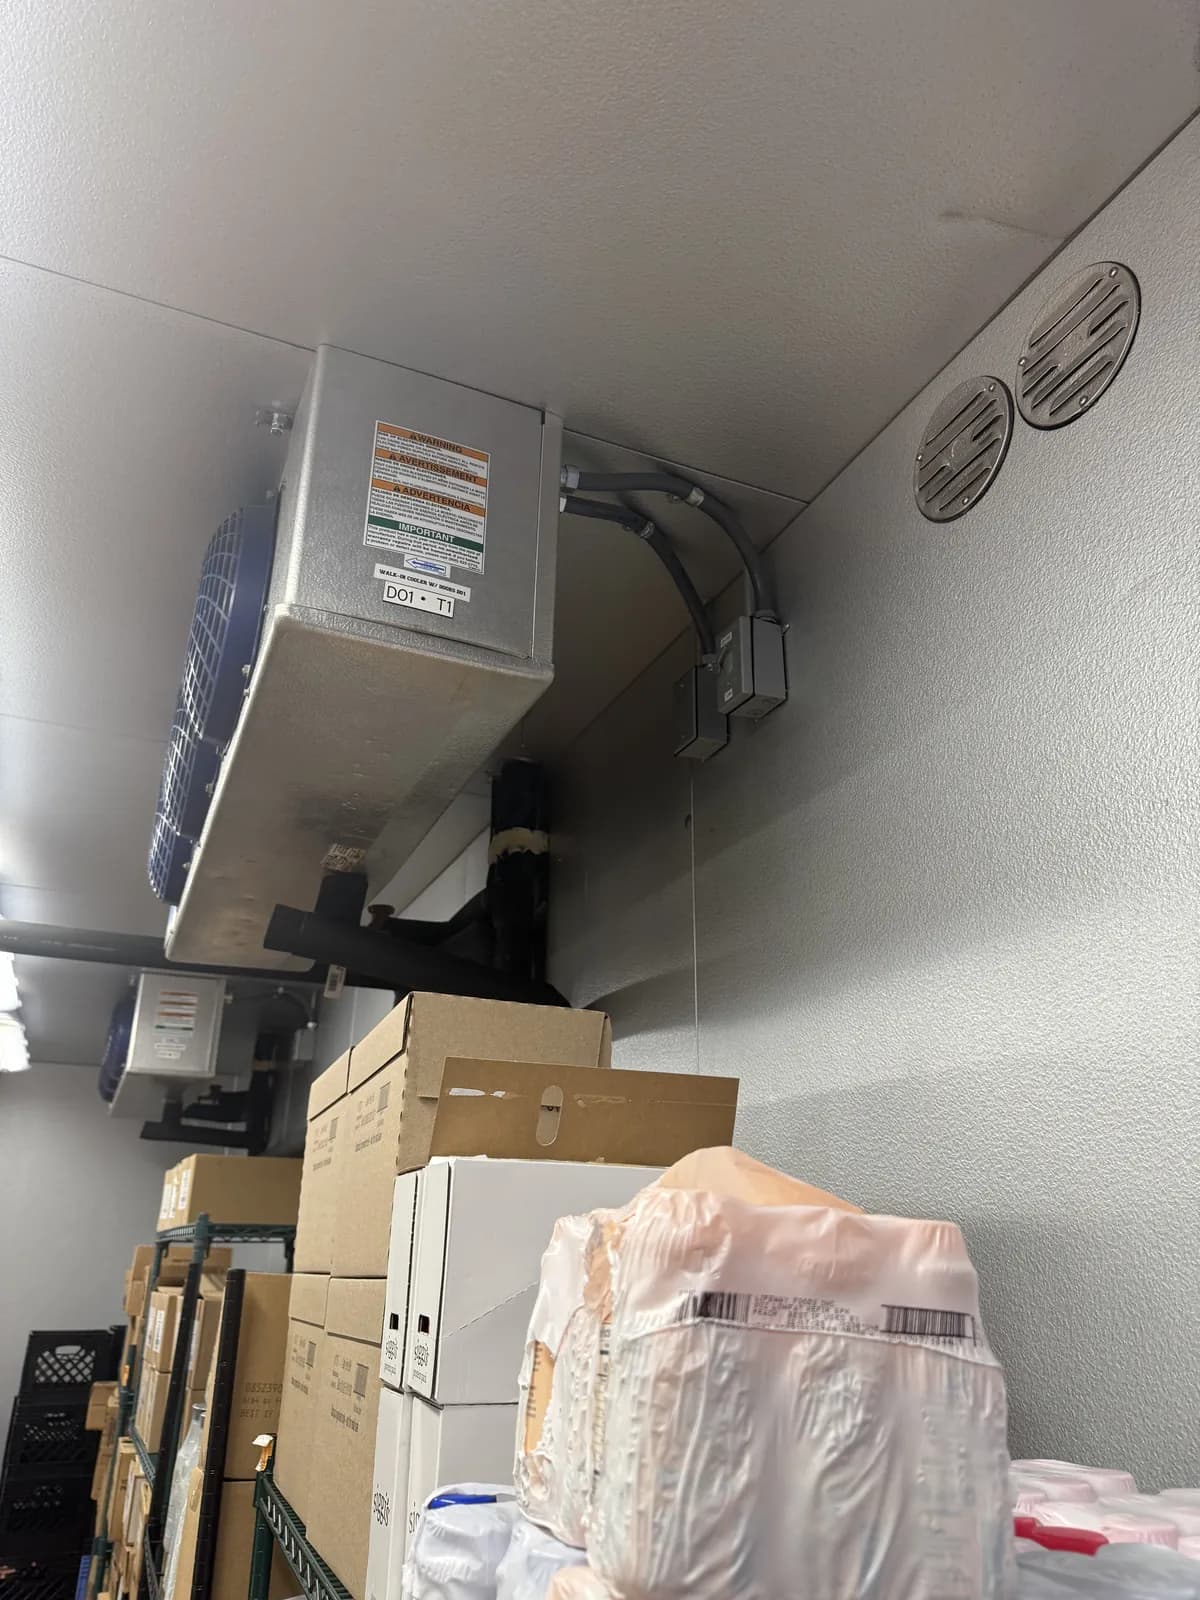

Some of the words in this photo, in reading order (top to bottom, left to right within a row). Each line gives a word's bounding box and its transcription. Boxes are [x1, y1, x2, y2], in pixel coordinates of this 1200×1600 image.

[418, 433, 462, 453] WARNING
[399, 455, 478, 483] AVERTISSEMENT
[401, 486, 471, 512] ADVERTENCIA
[398, 522, 455, 543] IMPORTANT
[436, 597, 452, 613] T1
